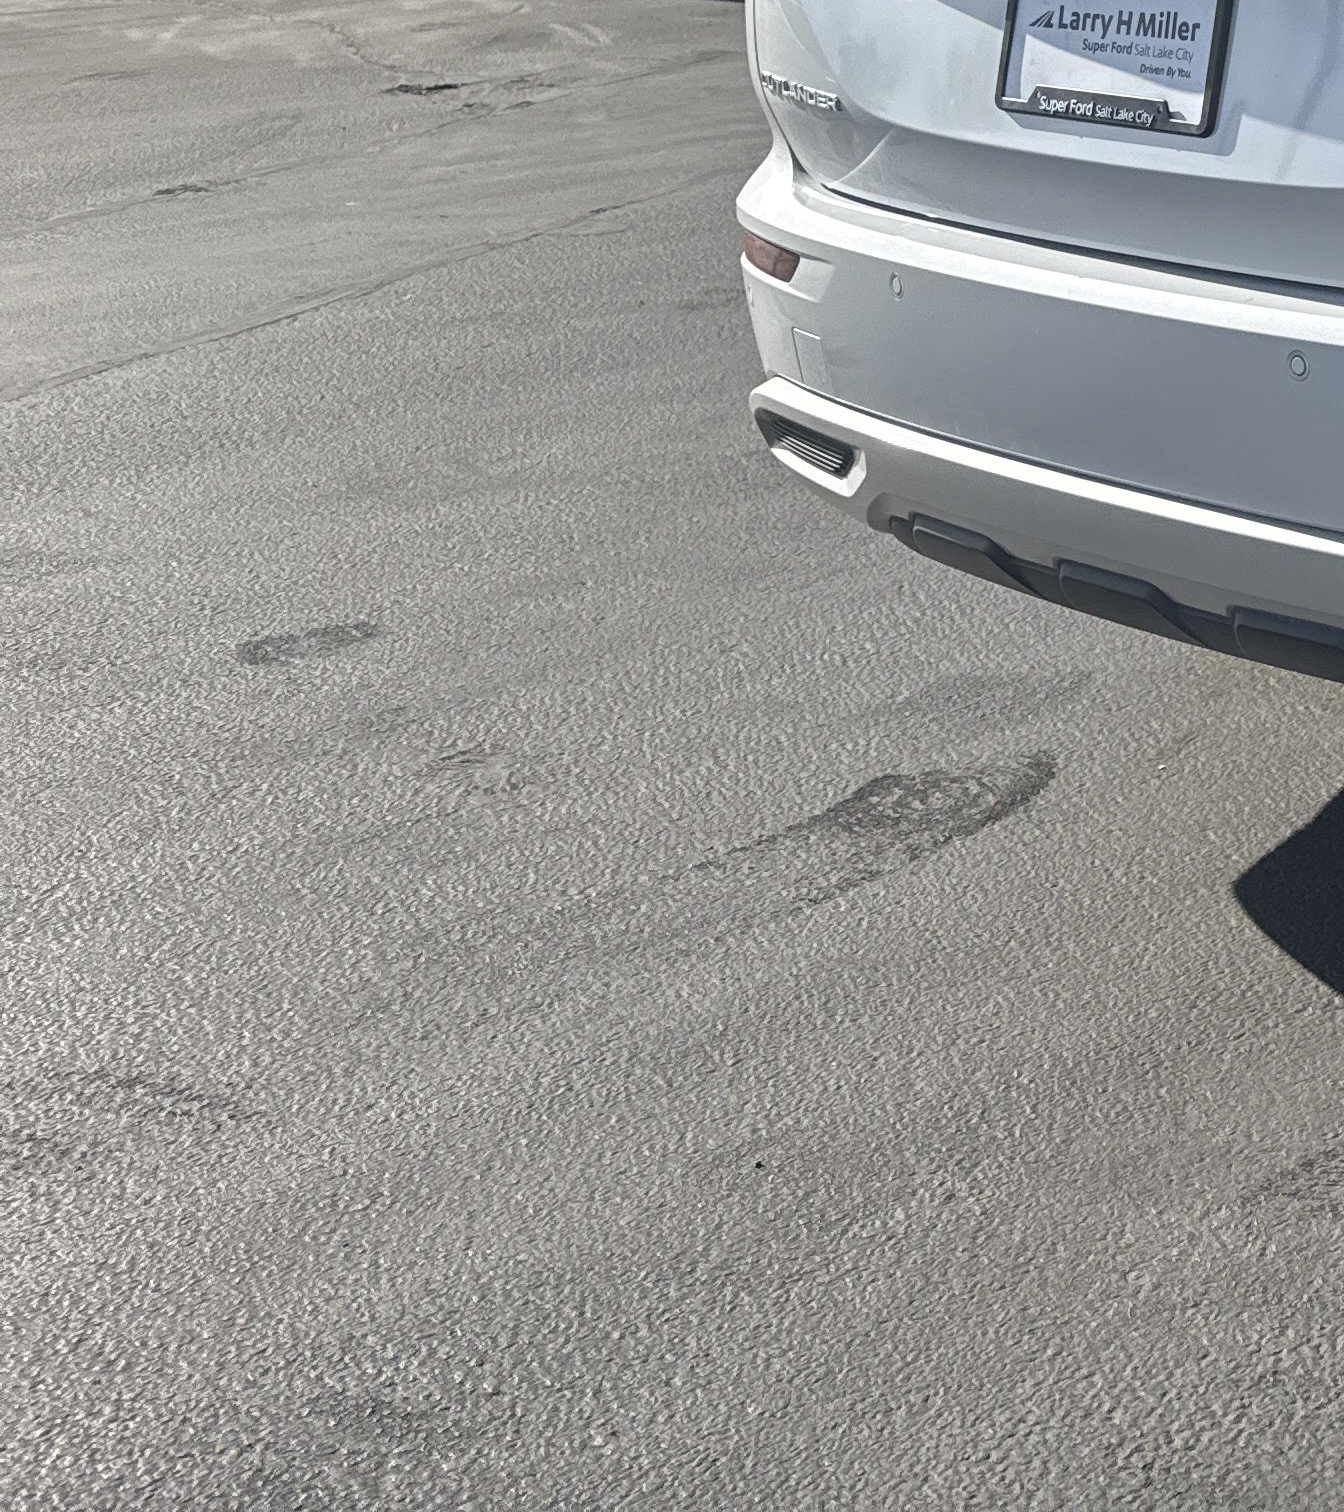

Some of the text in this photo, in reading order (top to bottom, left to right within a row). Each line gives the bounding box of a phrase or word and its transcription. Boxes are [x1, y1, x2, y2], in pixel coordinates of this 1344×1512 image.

[1057, 5, 1200, 41] Larry H Miller
[1082, 38, 1194, 64] Super Ford Salt Lake City
[1140, 64, 1191, 79] Driven By You
[1040, 95, 1154, 127] Super Ford Salt Lake City
